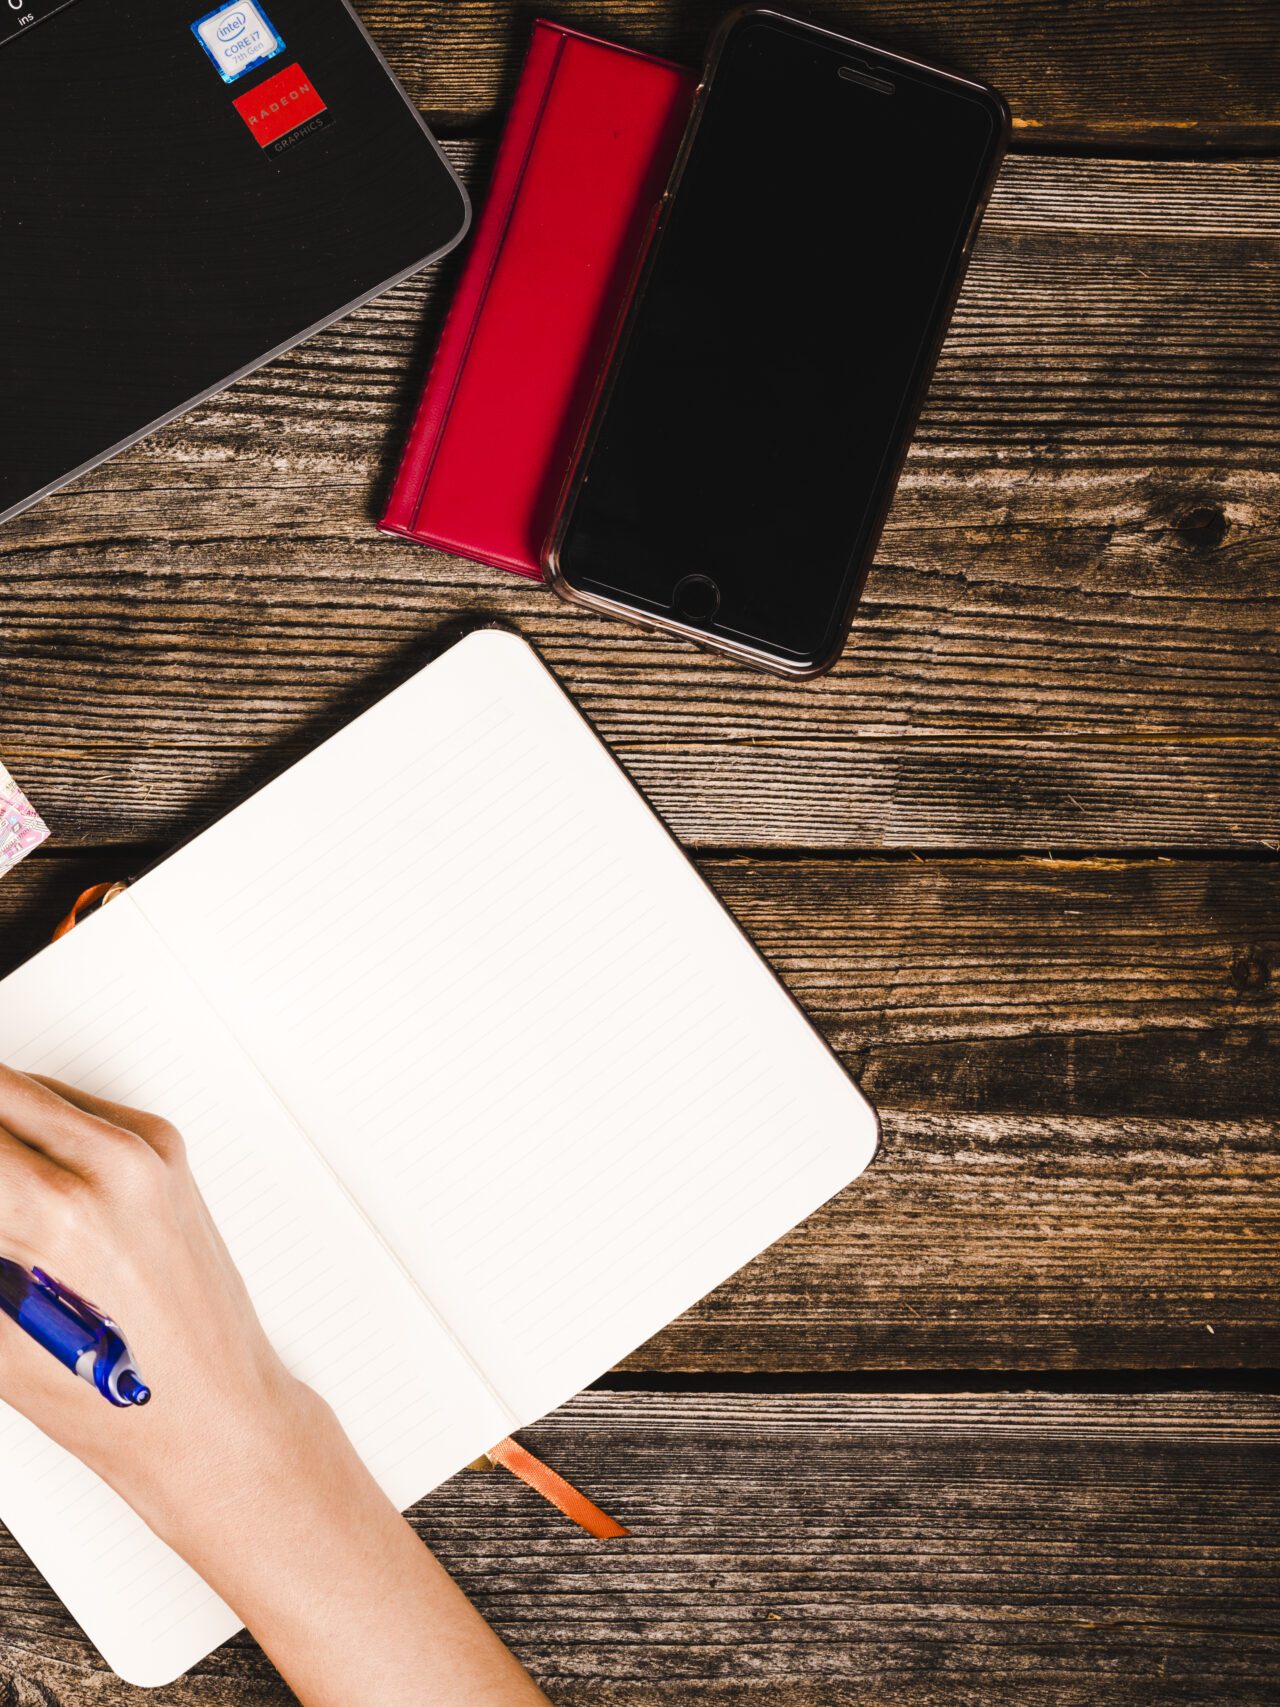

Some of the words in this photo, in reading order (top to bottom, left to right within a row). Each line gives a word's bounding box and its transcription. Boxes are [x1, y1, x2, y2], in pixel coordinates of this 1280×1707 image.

[17, 13, 34, 26] ins
[220, 16, 243, 36] intel
[224, 38, 250, 58] CORE
[251, 30, 261, 42] i7
[233, 52, 247, 63] 7th
[247, 42, 264, 55] Gen
[248, 84, 310, 126] RADEON
[274, 118, 324, 152] GRAPHICS
